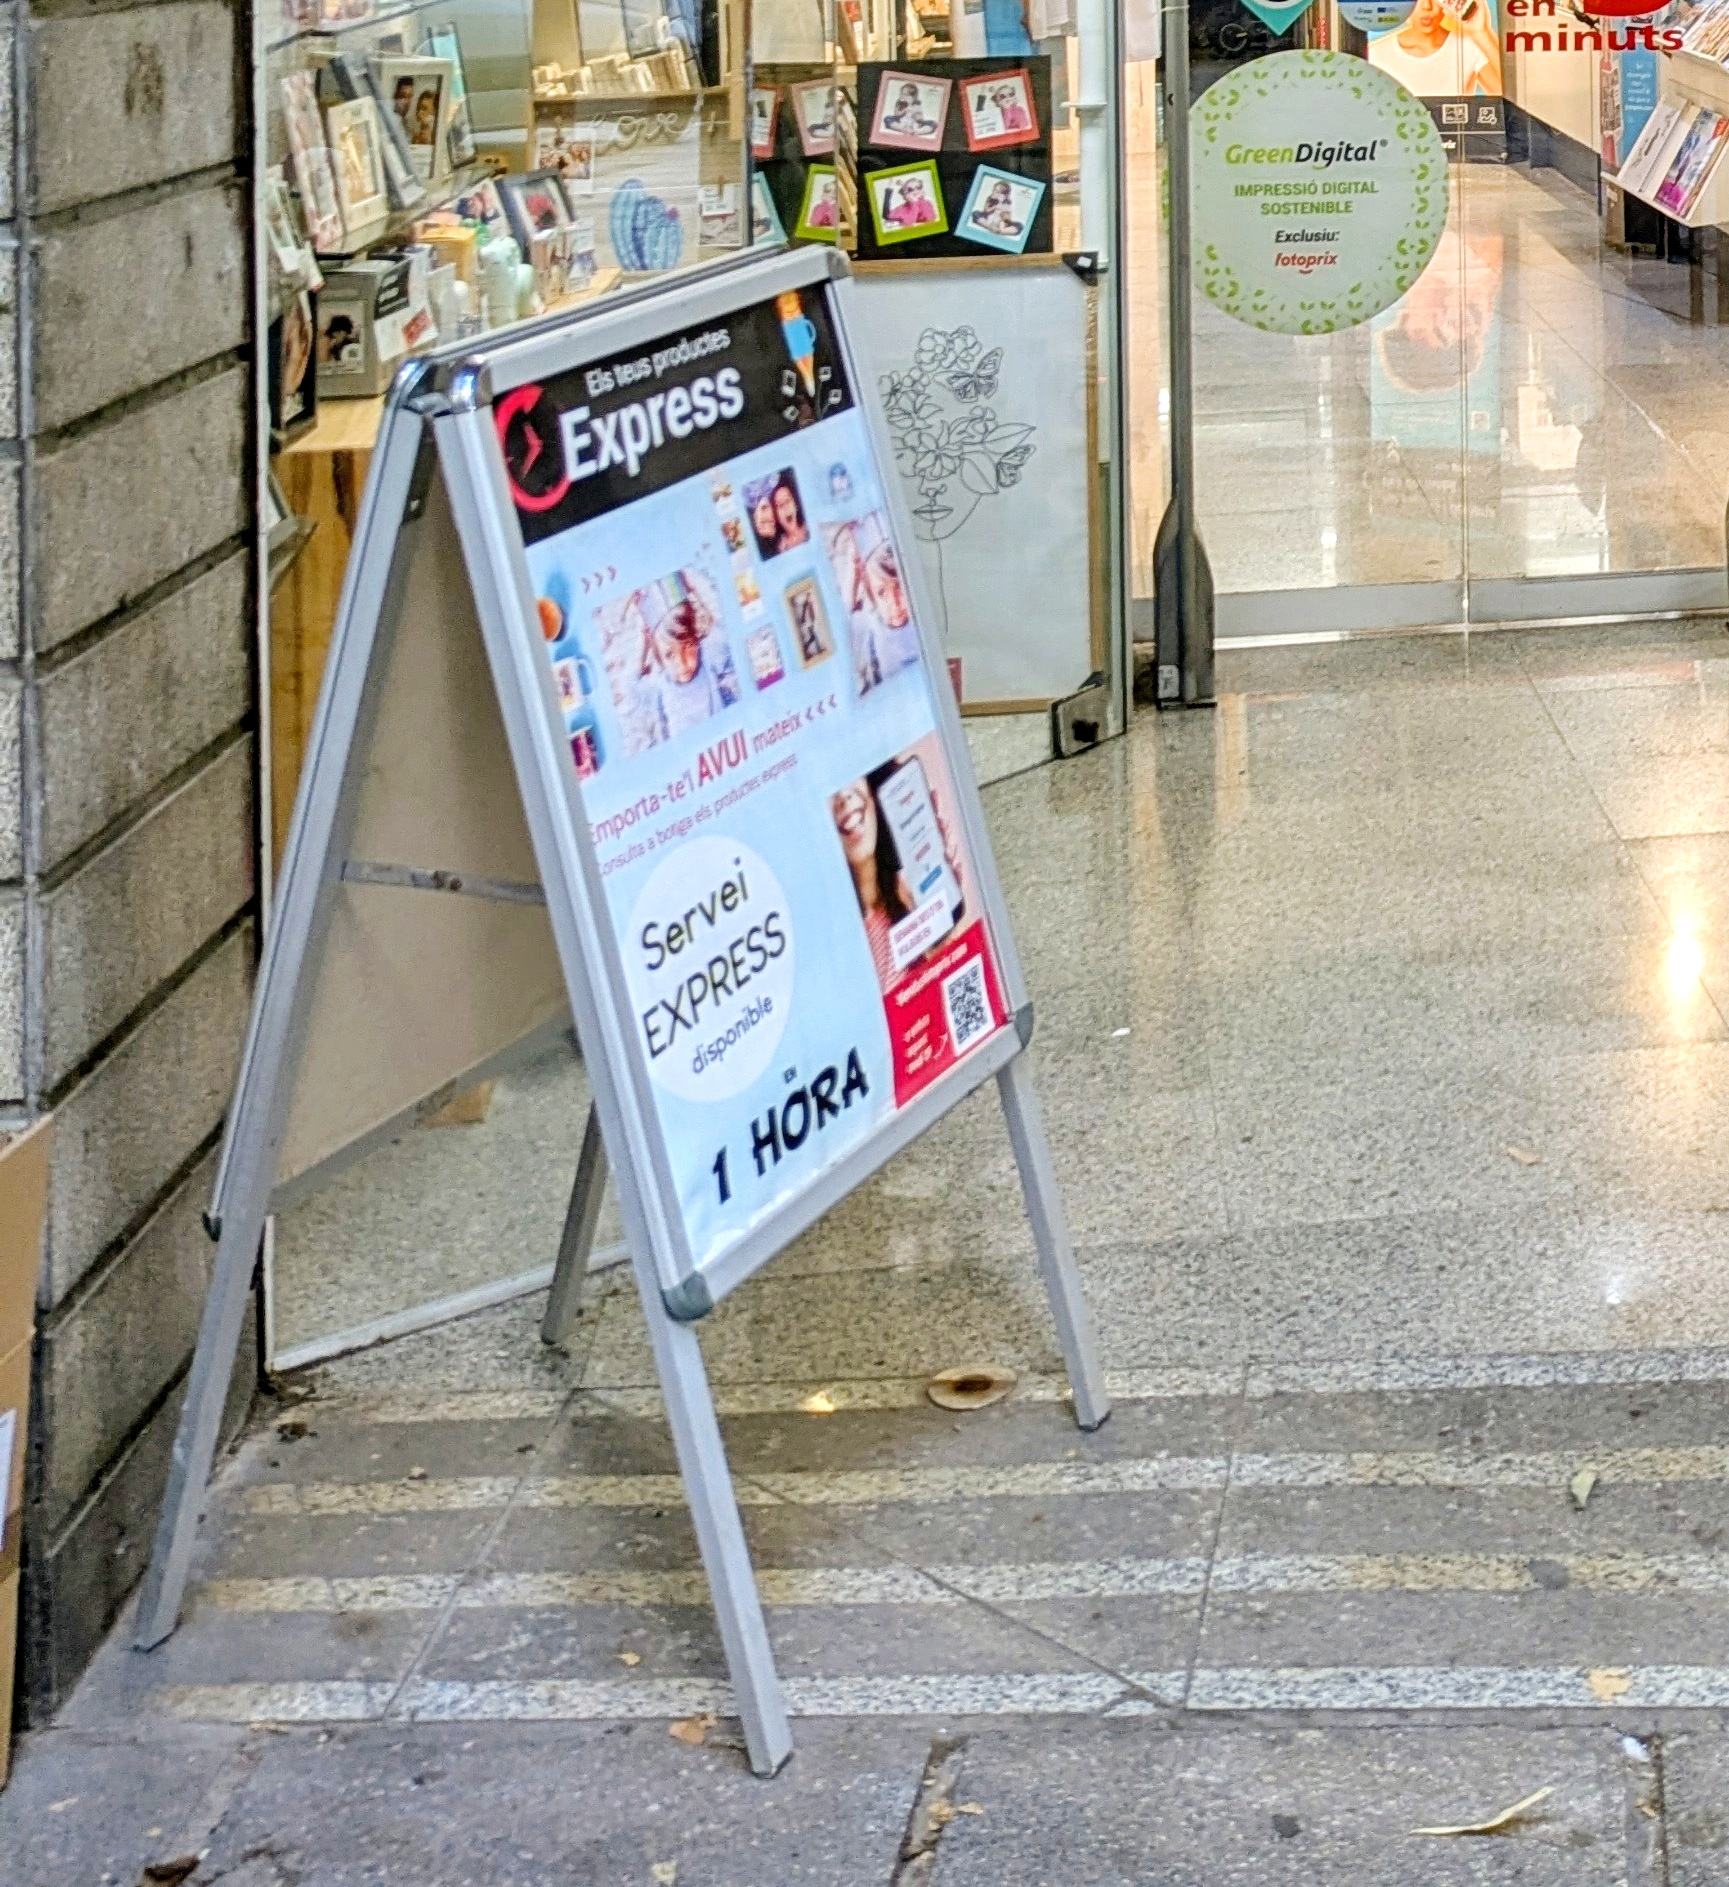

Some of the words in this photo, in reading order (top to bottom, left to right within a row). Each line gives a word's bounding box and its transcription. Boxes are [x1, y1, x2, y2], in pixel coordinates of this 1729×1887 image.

[1506, 23, 1684, 52] minuts
[1234, 179, 1319, 197] IMPRESSIÓ
[1321, 181, 1379, 196] DIGITAL
[1260, 200, 1353, 216] SOSTENIBLE
[1274, 251, 1338, 267] fotoprix
[584, 368, 614, 397] Els
[614, 355, 652, 390] teus
[653, 326, 731, 377] productes
[559, 366, 745, 482] Express
[697, 728, 749, 787] AVUI
[641, 858, 752, 972] Servei
[641, 910, 787, 1060] EXPRESS
[692, 995, 774, 1074] disponible
[711, 1145, 733, 1205] 1
[751, 1046, 870, 1177] HORA
